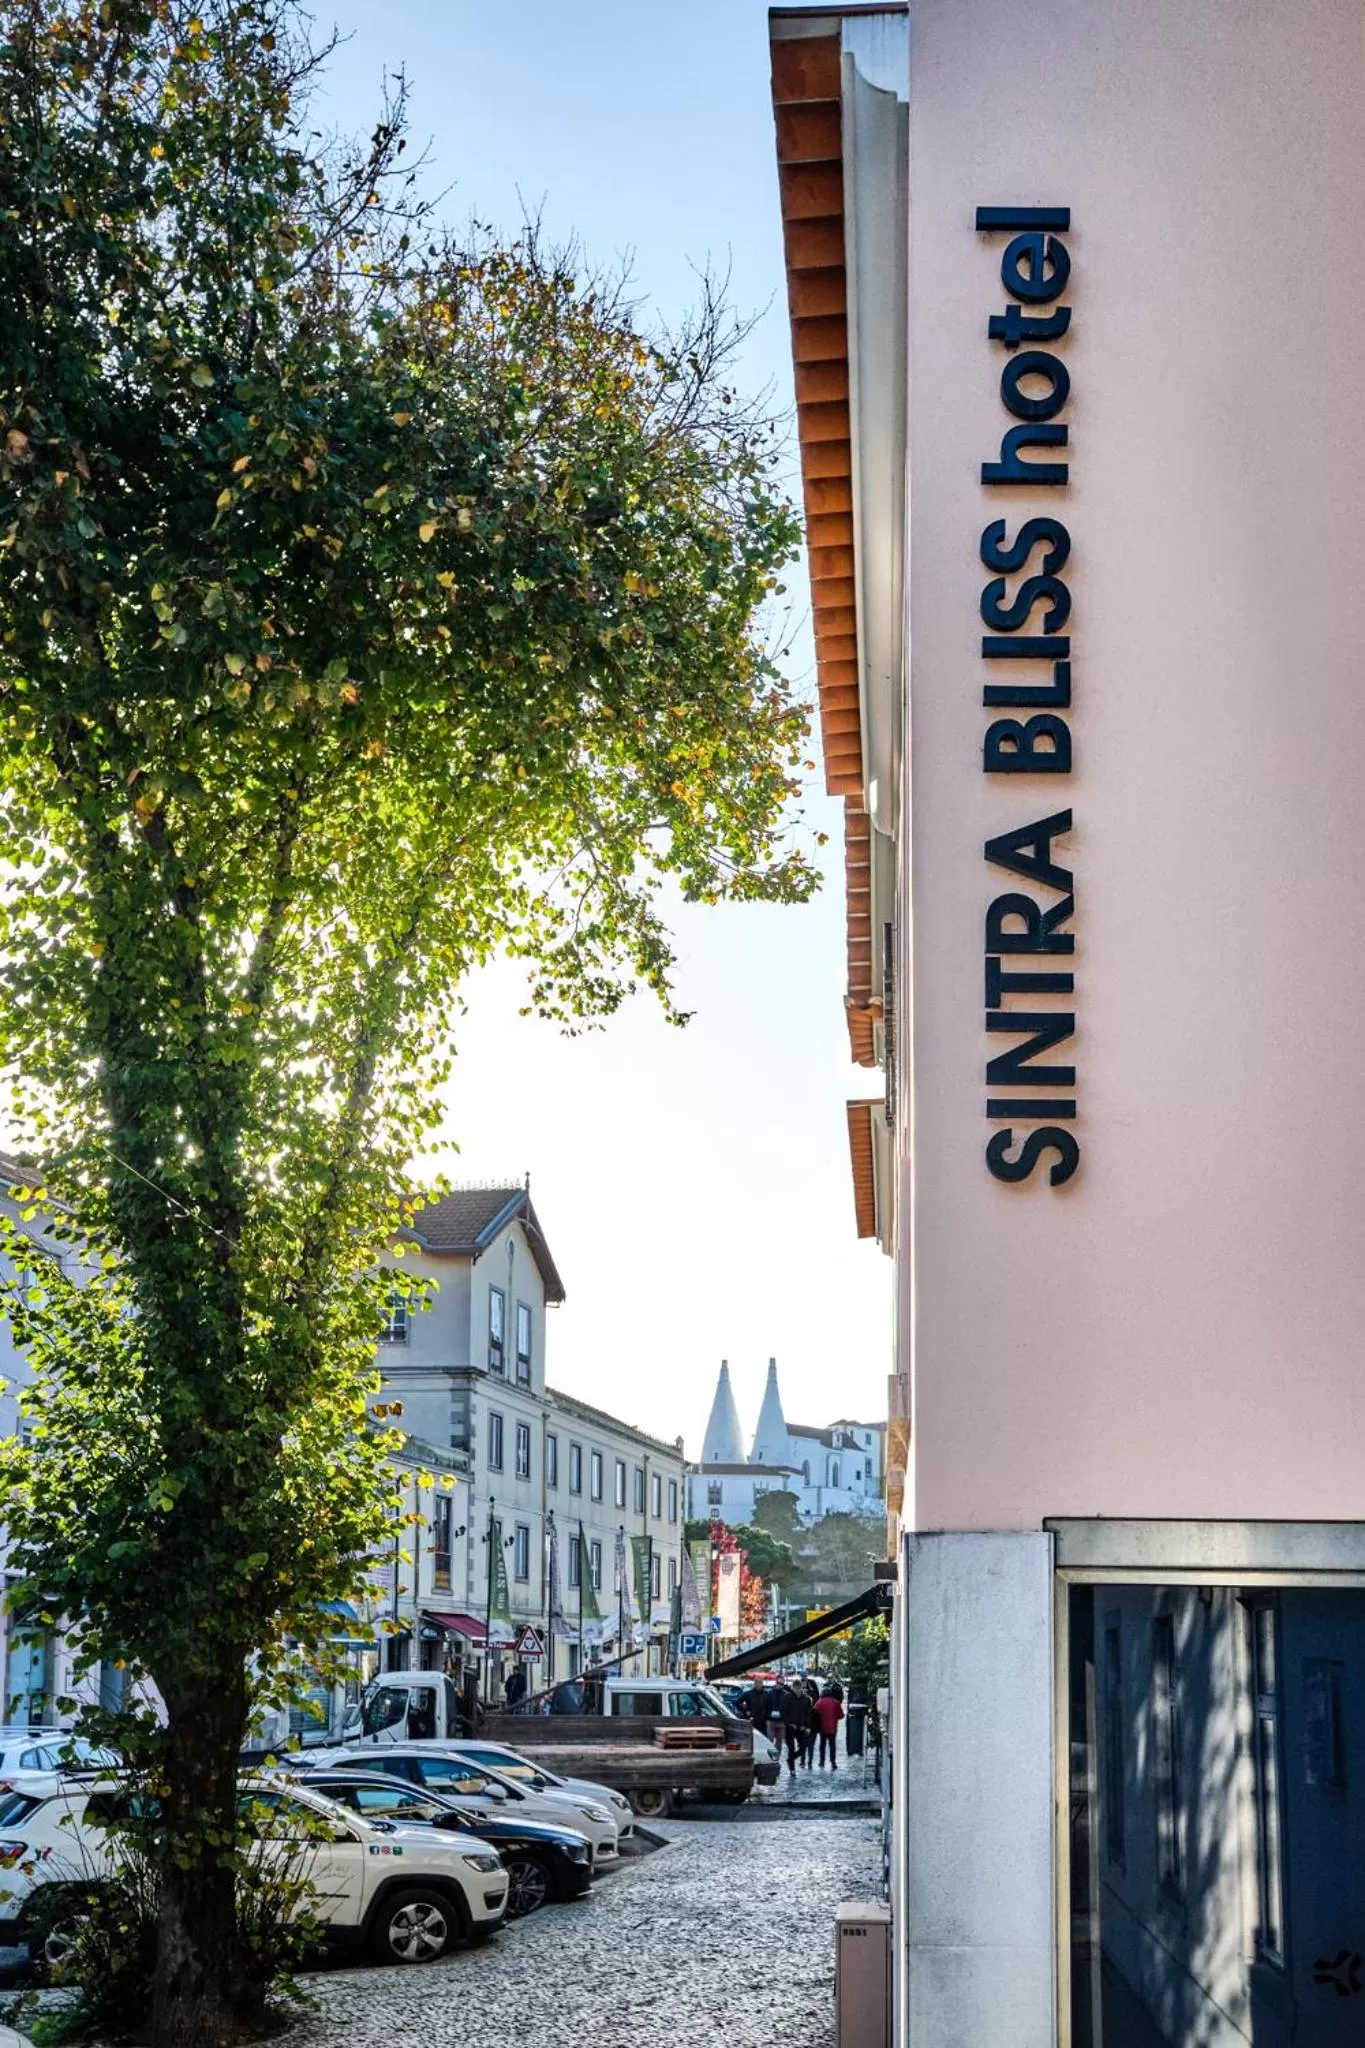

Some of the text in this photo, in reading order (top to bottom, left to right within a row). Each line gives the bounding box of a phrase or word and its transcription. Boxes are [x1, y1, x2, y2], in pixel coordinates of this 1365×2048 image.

[976, 207, 1079, 1187] SINTRA BLISS hotel
[683, 1636, 696, 1653] P
